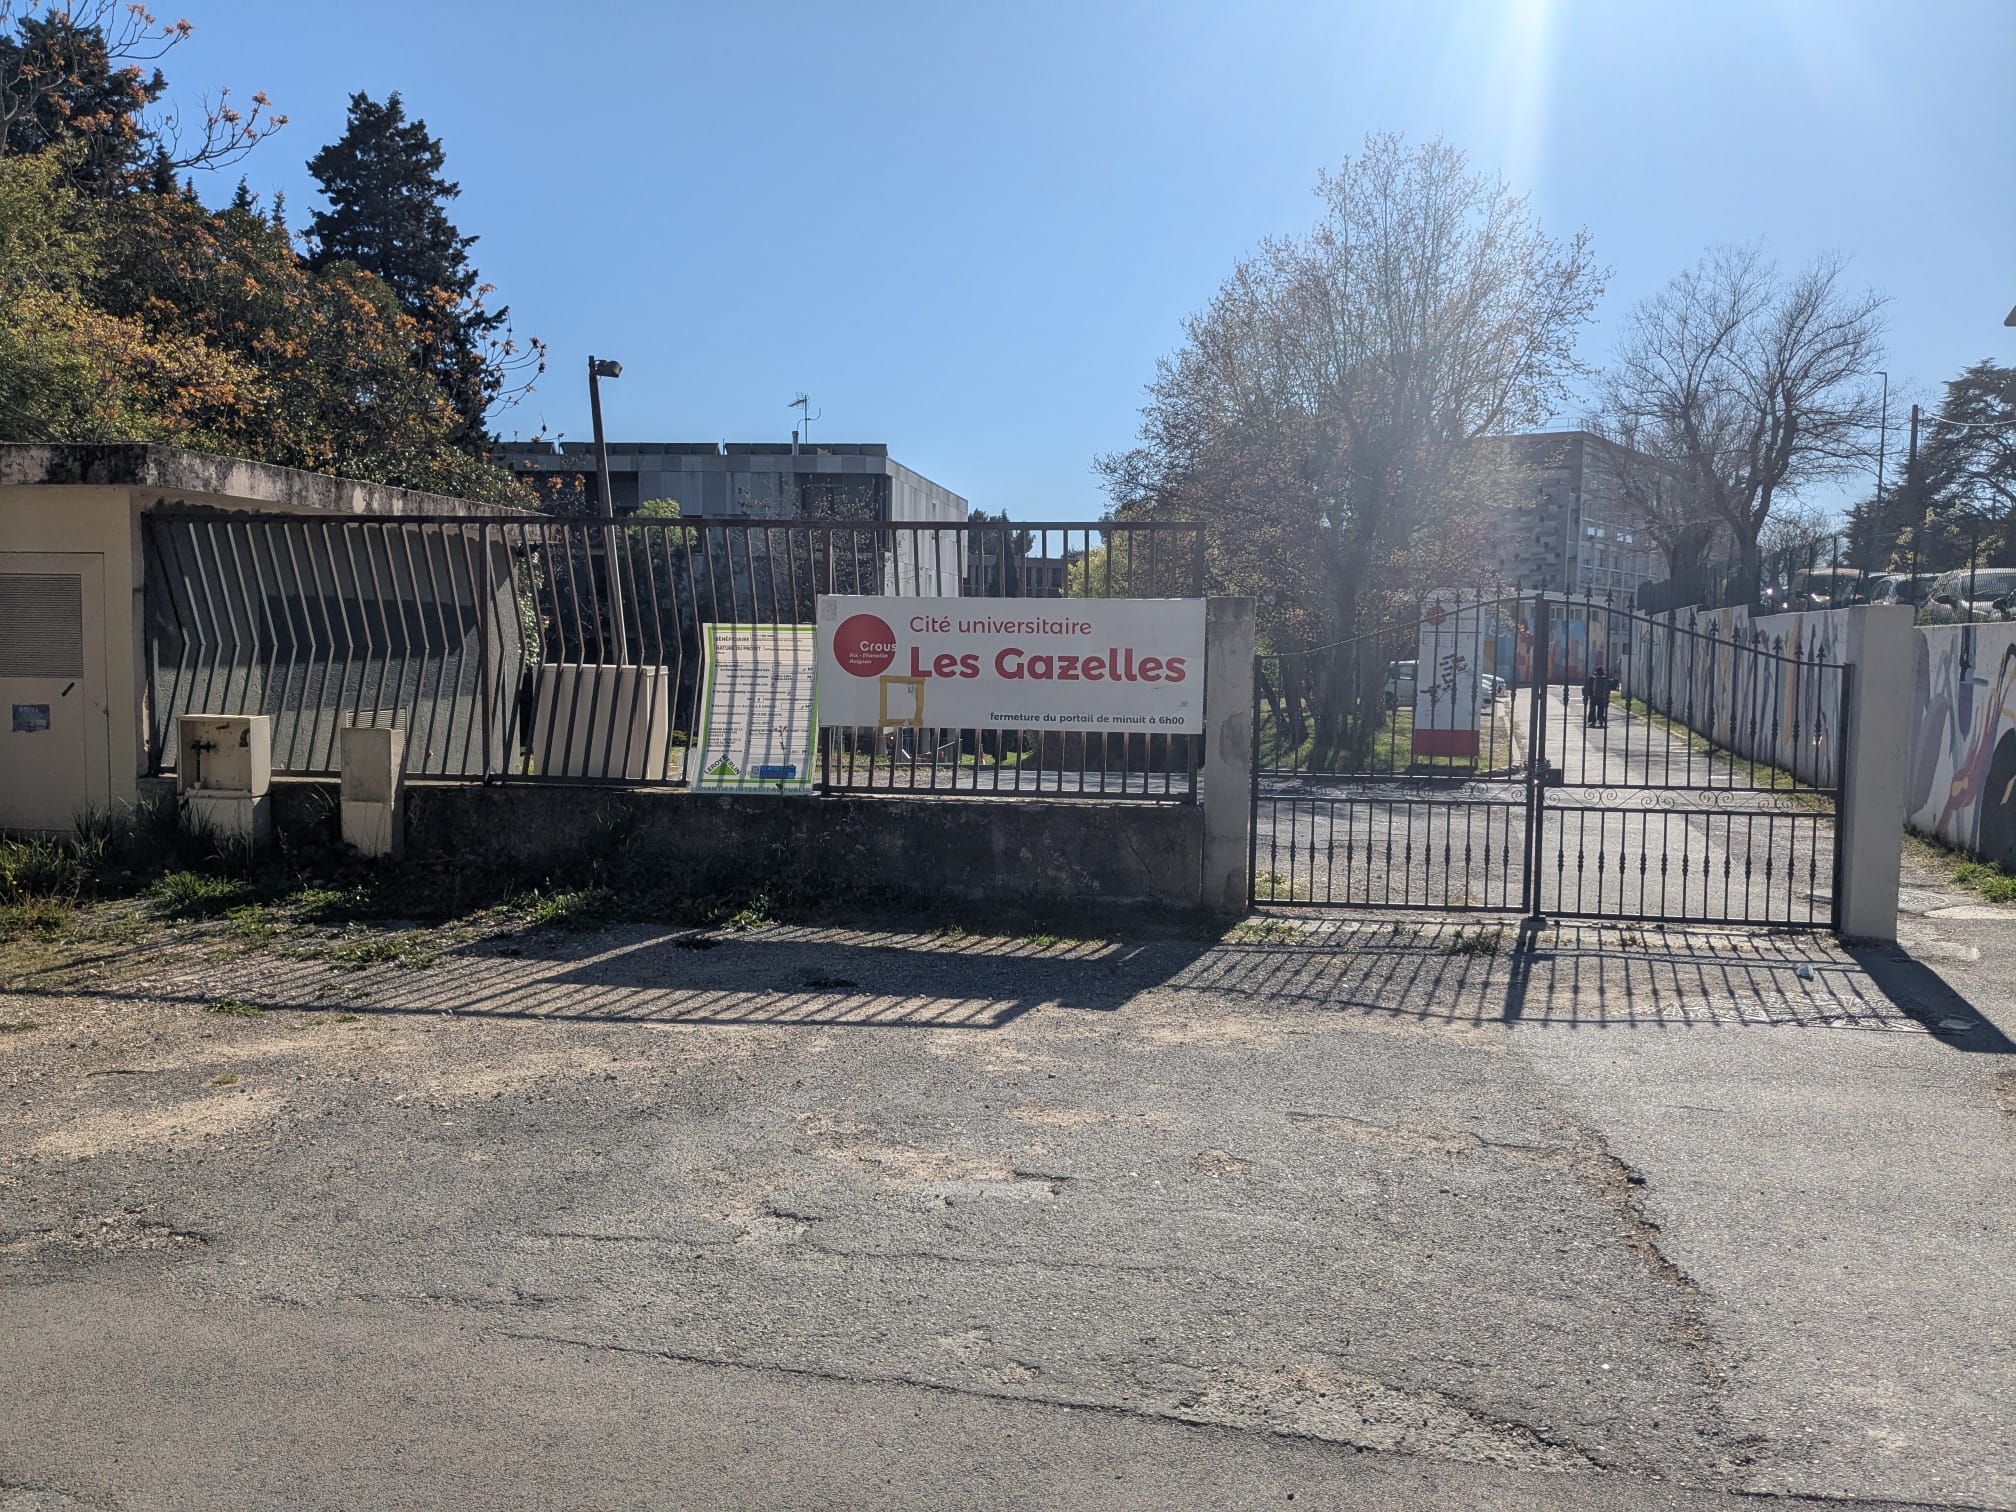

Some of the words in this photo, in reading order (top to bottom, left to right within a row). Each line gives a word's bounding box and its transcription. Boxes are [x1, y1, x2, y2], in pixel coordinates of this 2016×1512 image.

[909, 615, 951, 633] Cité
[958, 616, 1092, 635] universitaire
[860, 640, 896, 652] Crous
[911, 646, 980, 679] Les
[994, 647, 1186, 683] Gazelles
[990, 712, 1041, 722] fermeture
[1043, 713, 1056, 722] du
[1059, 713, 1094, 724] portail
[1096, 714, 1110, 723] de
[1112, 714, 1147, 724] minuit
[1149, 715, 1156, 724] à
[1159, 716, 1185, 725] 6h00
[703, 757, 723, 775] LEROY
[721, 753, 741, 775] MERLIN
